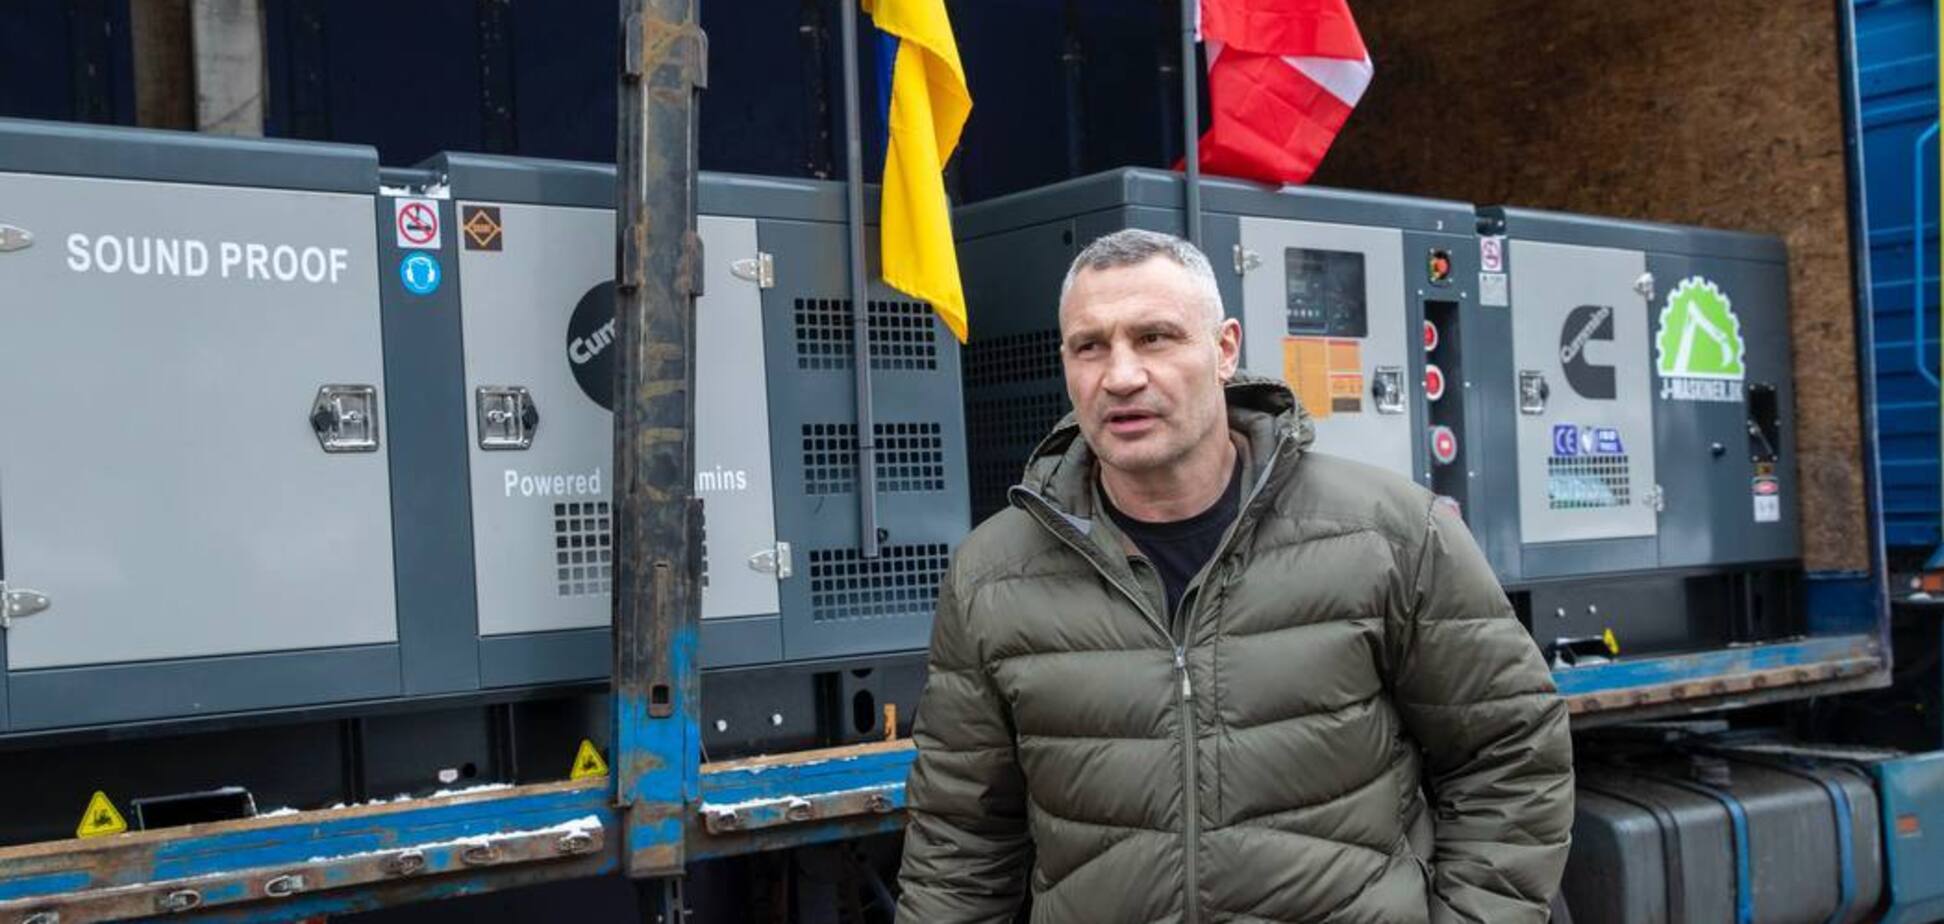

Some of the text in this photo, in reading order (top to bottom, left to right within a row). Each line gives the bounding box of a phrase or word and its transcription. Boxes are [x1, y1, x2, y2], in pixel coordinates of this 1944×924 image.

[67, 233, 349, 284] SOUND PROOF
[504, 465, 747, 497] Powered mins
